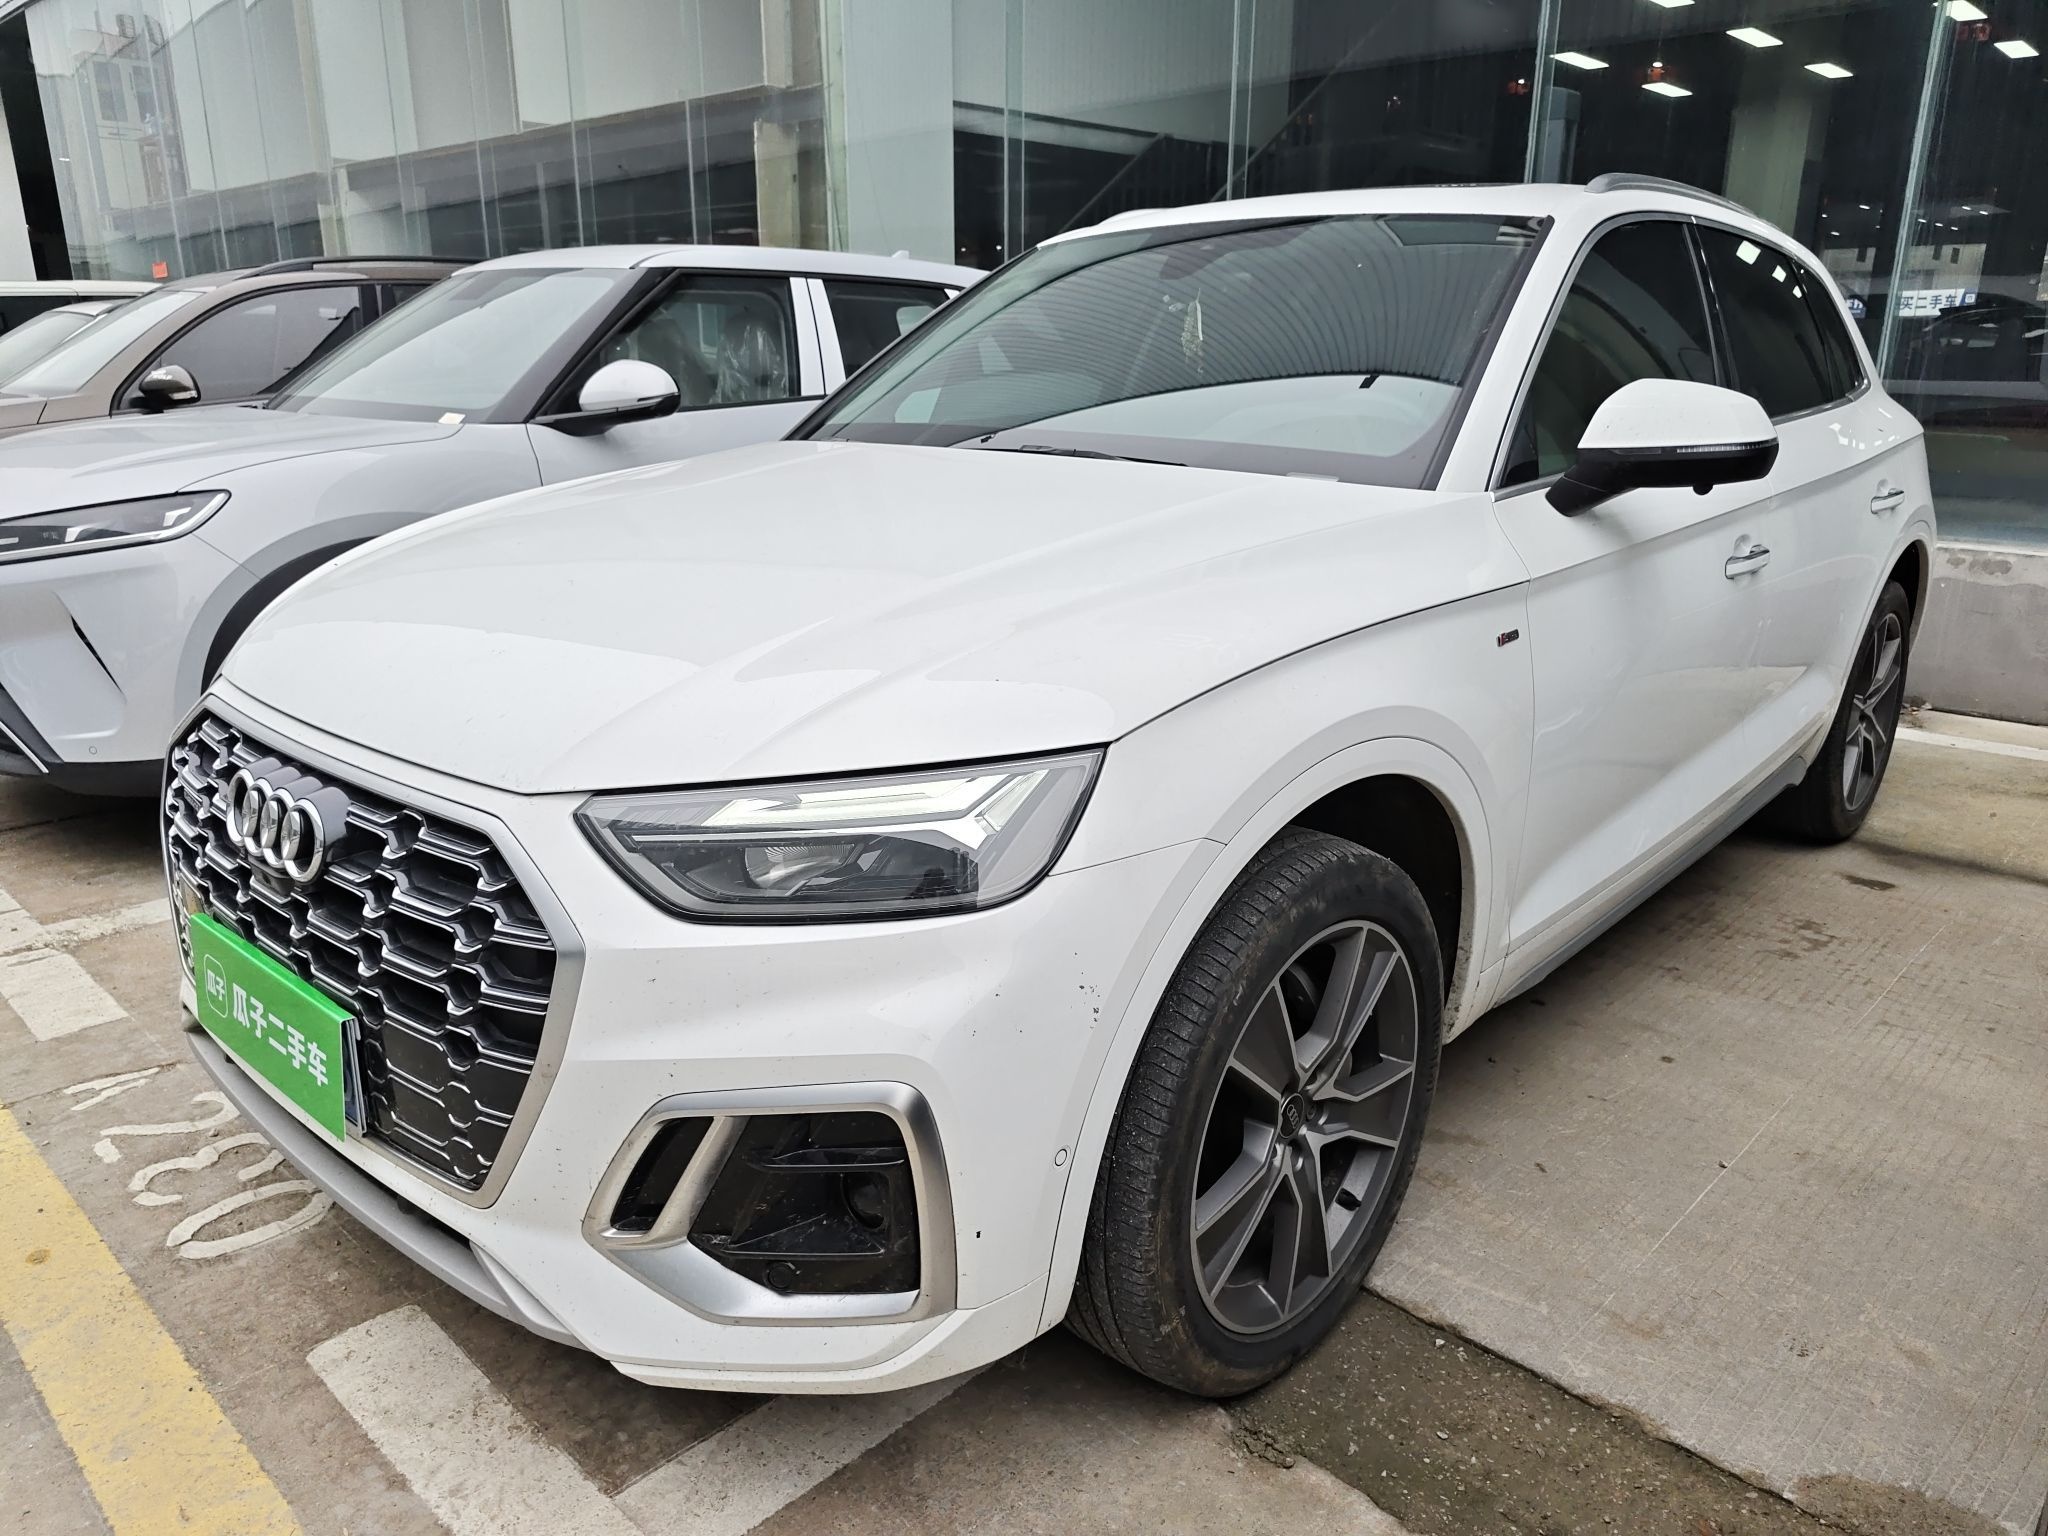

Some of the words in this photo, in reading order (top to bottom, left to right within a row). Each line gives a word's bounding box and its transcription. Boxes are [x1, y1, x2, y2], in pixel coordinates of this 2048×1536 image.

[207, 969, 226, 1001] 瓜子
[233, 983, 328, 1087] 瓜子二手车
